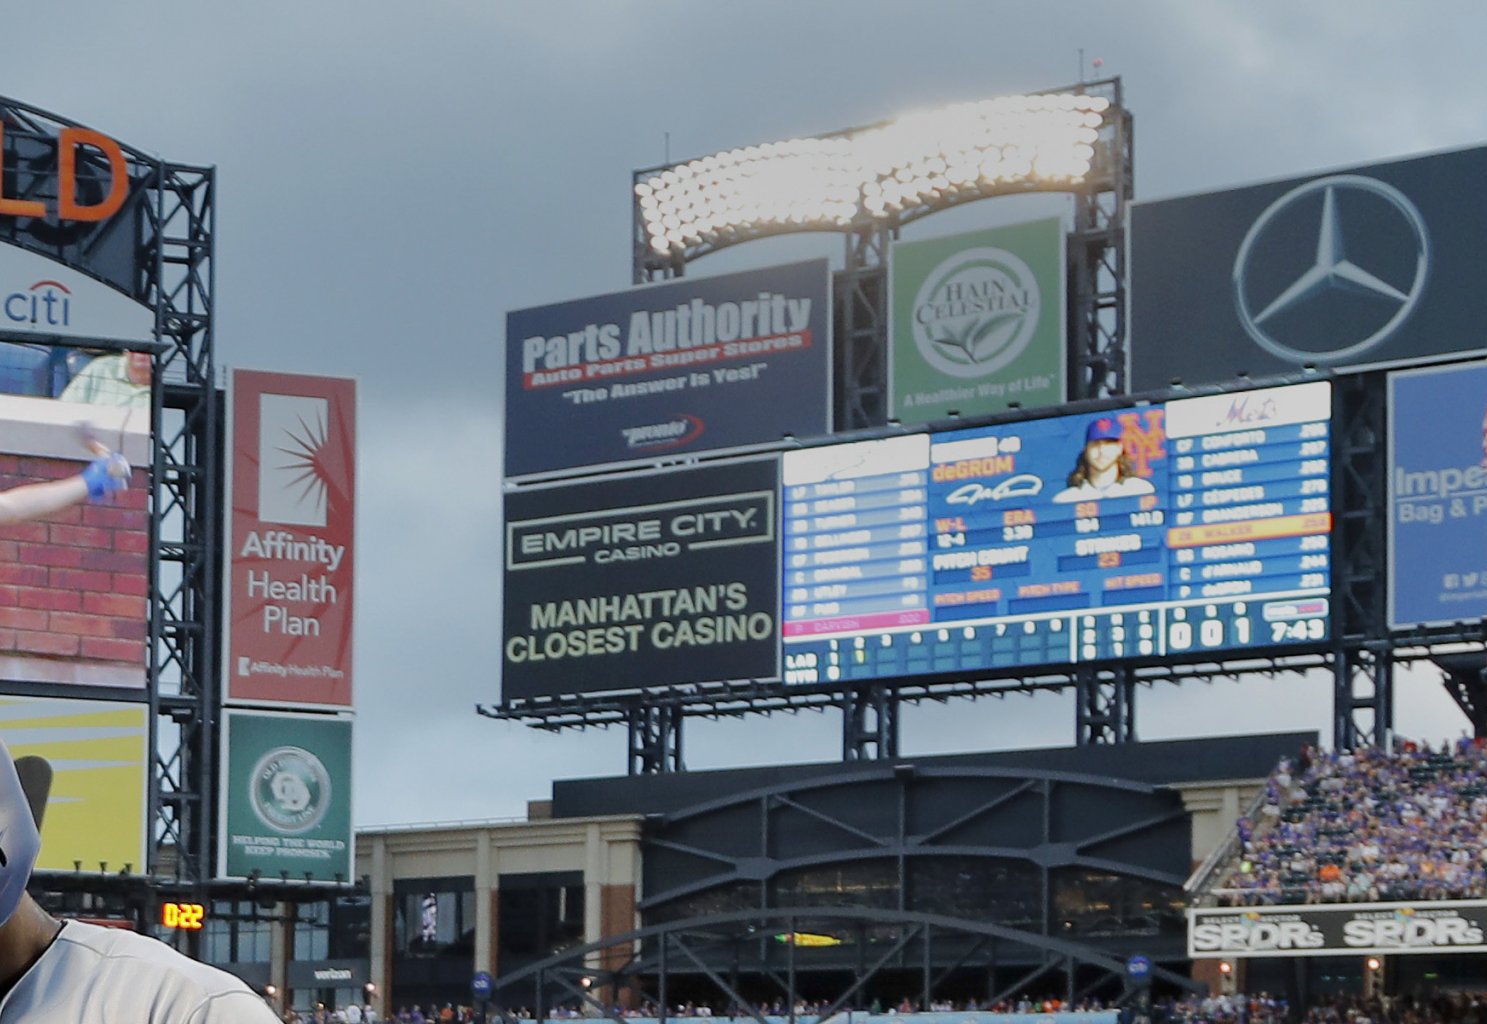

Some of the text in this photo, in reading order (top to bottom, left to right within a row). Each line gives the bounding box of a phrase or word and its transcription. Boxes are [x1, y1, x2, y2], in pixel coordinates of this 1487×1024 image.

[4, 285, 70, 326] citi
[946, 280, 1005, 302] HAIN
[522, 291, 811, 374] Parts Authority
[531, 333, 804, 387] Auto Parts Super Stores
[611, 377, 688, 400] Answer
[1003, 508, 1037, 526] ERA
[1399, 503, 1444, 524] Bag
[1449, 498, 1467, 518] &
[520, 518, 662, 555] EMPIRE
[670, 507, 758, 537] CITY
[240, 530, 345, 572] Affinity
[594, 542, 681, 565] CASINO
[247, 569, 337, 604] Health
[264, 605, 321, 637] Plan
[530, 583, 748, 631] MANHATTAN'S
[506, 612, 773, 663] CLOSEST CASINO
[1169, 616, 1325, 650] 0 0 1 7:43
[283, 837, 305, 849] THE
[163, 902, 205, 930] 0:22
